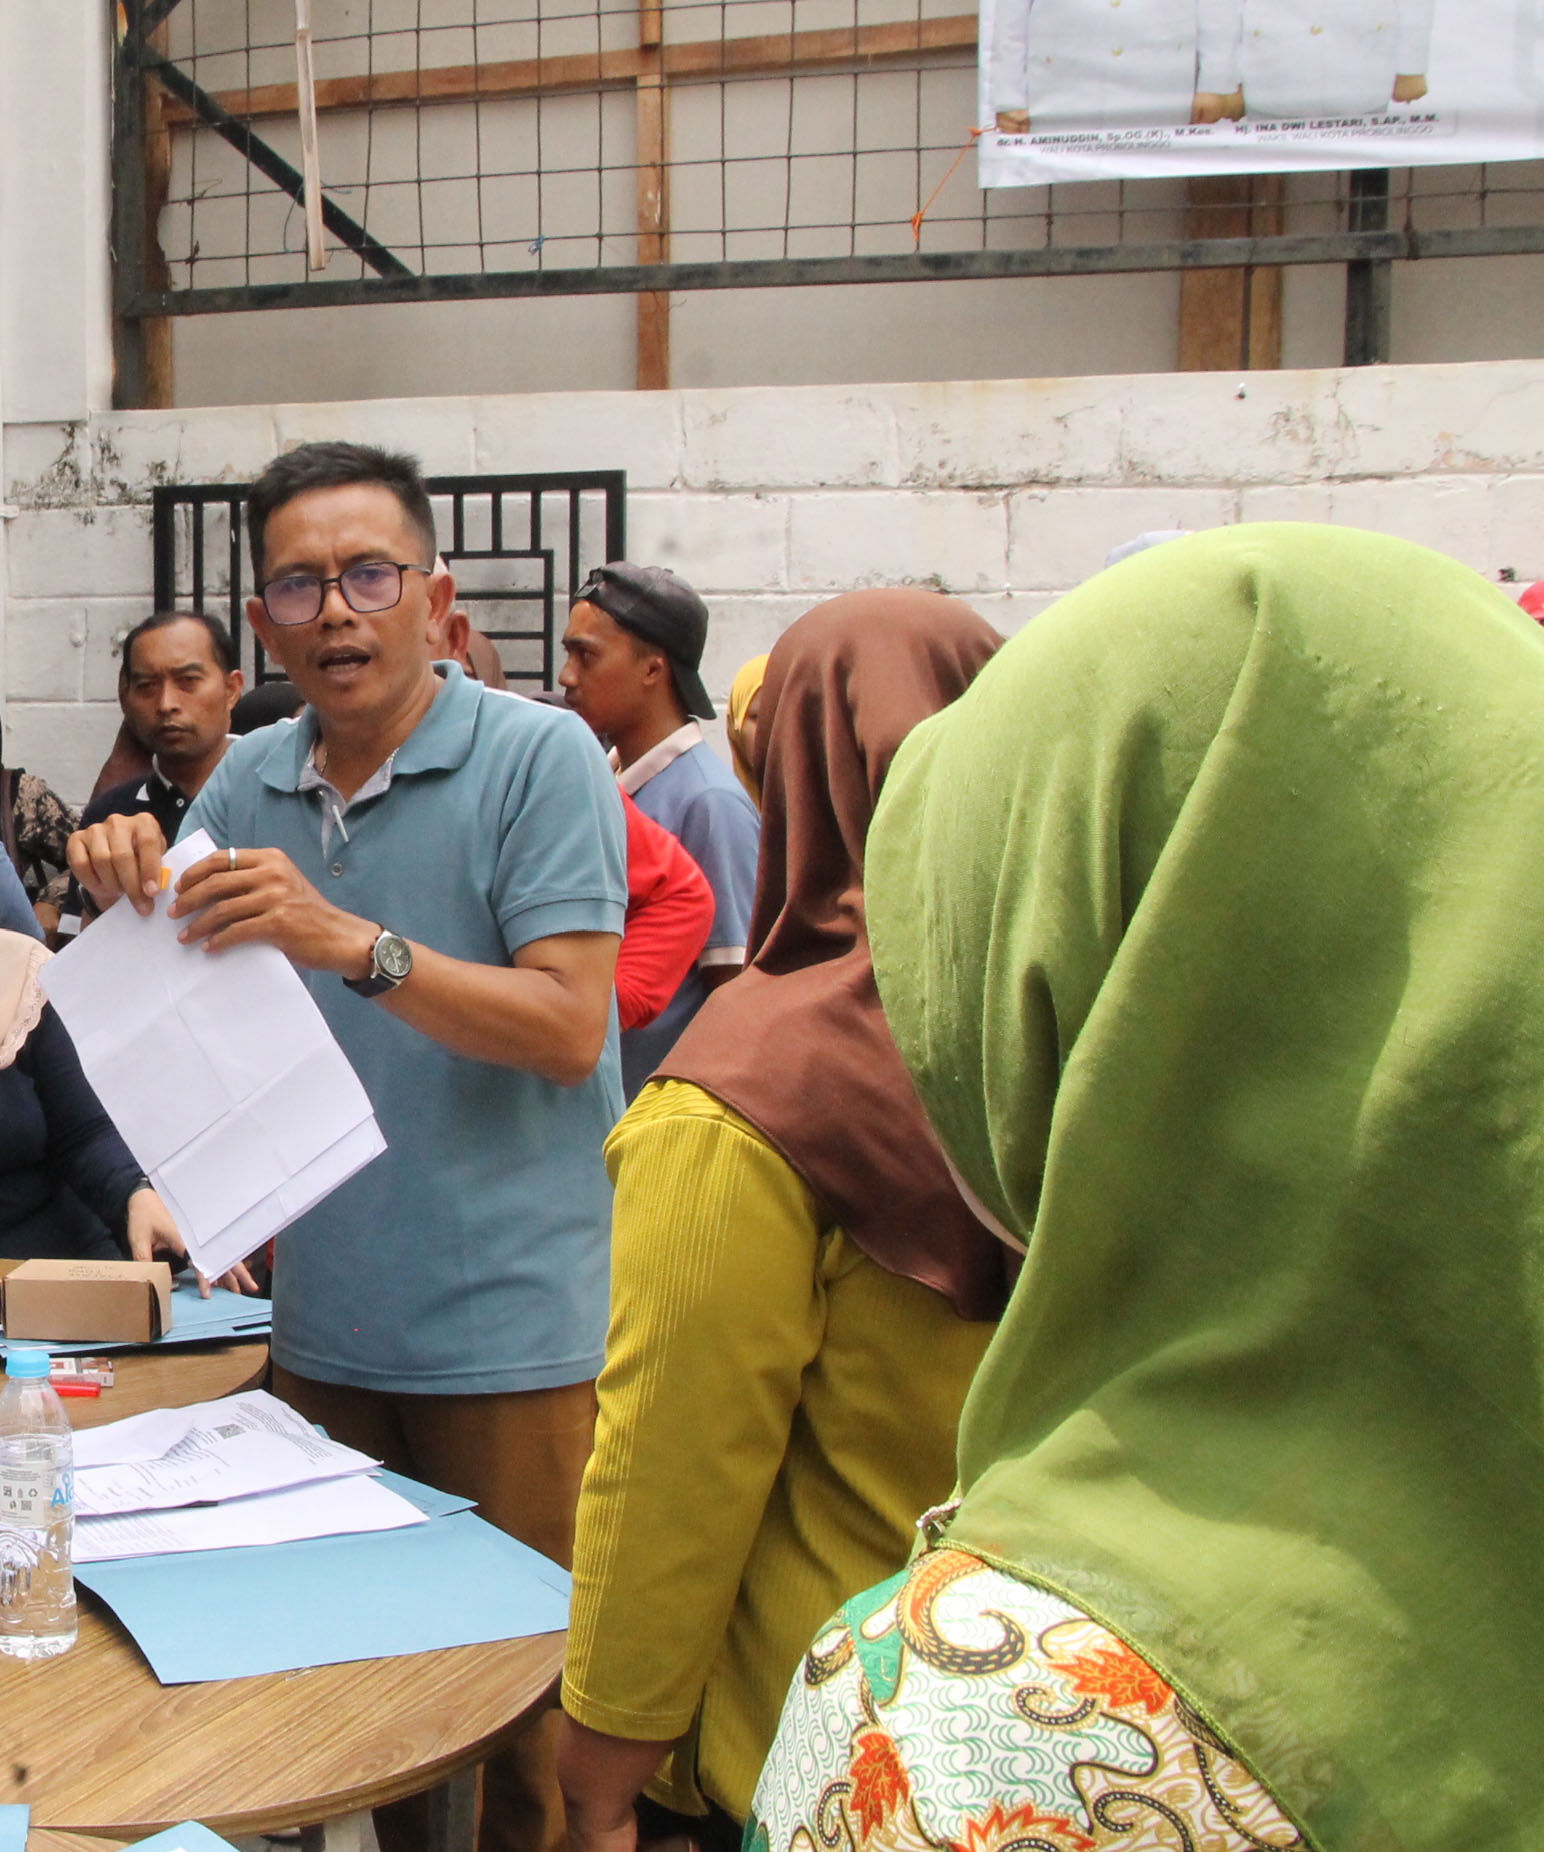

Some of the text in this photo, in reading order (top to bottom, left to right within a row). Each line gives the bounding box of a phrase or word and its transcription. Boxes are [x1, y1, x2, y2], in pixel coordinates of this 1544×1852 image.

[1256, 123, 1277, 133] INA
[1281, 121, 1306, 132] DWI
[1310, 118, 1367, 131] LESTARI,
[1014, 137, 1027, 146] H.
[1030, 132, 1103, 146] AMINUDDIN,
